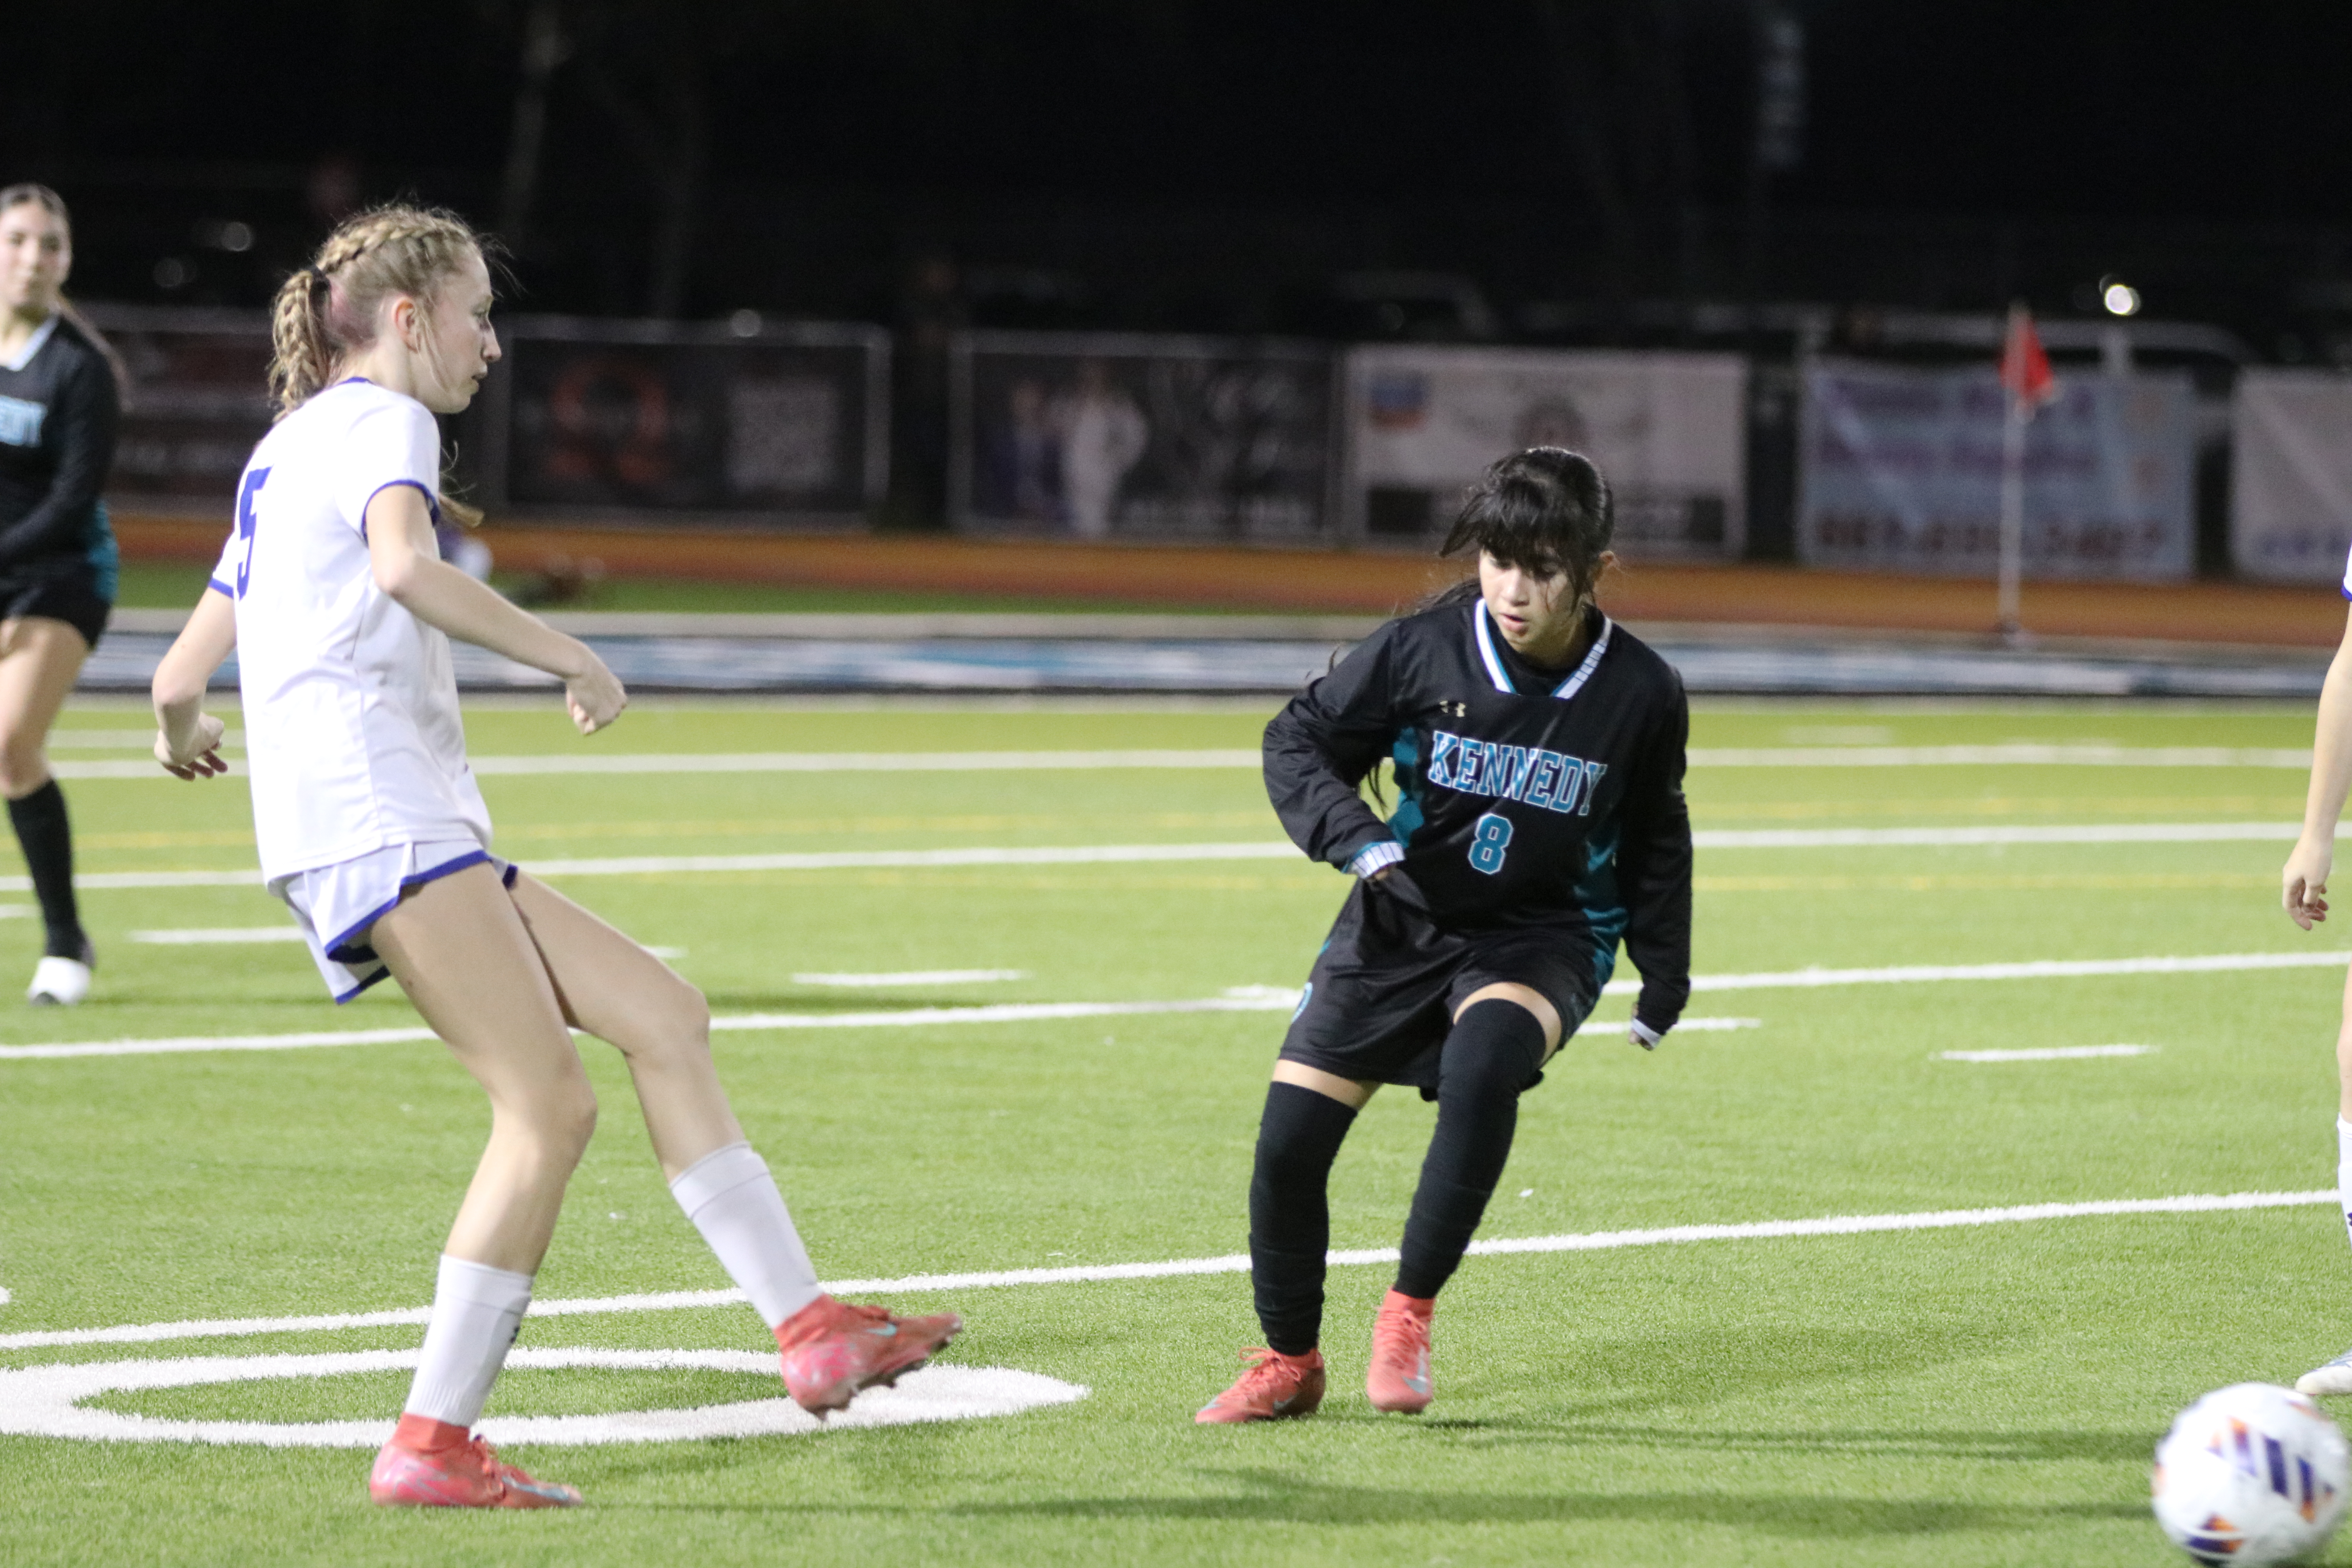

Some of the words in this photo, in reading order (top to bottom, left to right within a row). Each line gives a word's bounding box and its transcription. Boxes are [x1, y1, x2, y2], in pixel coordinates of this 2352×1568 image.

[237, 463, 274, 602] 5
[1428, 730, 1608, 816] KENNEDY
[1468, 812, 1514, 875] 8
